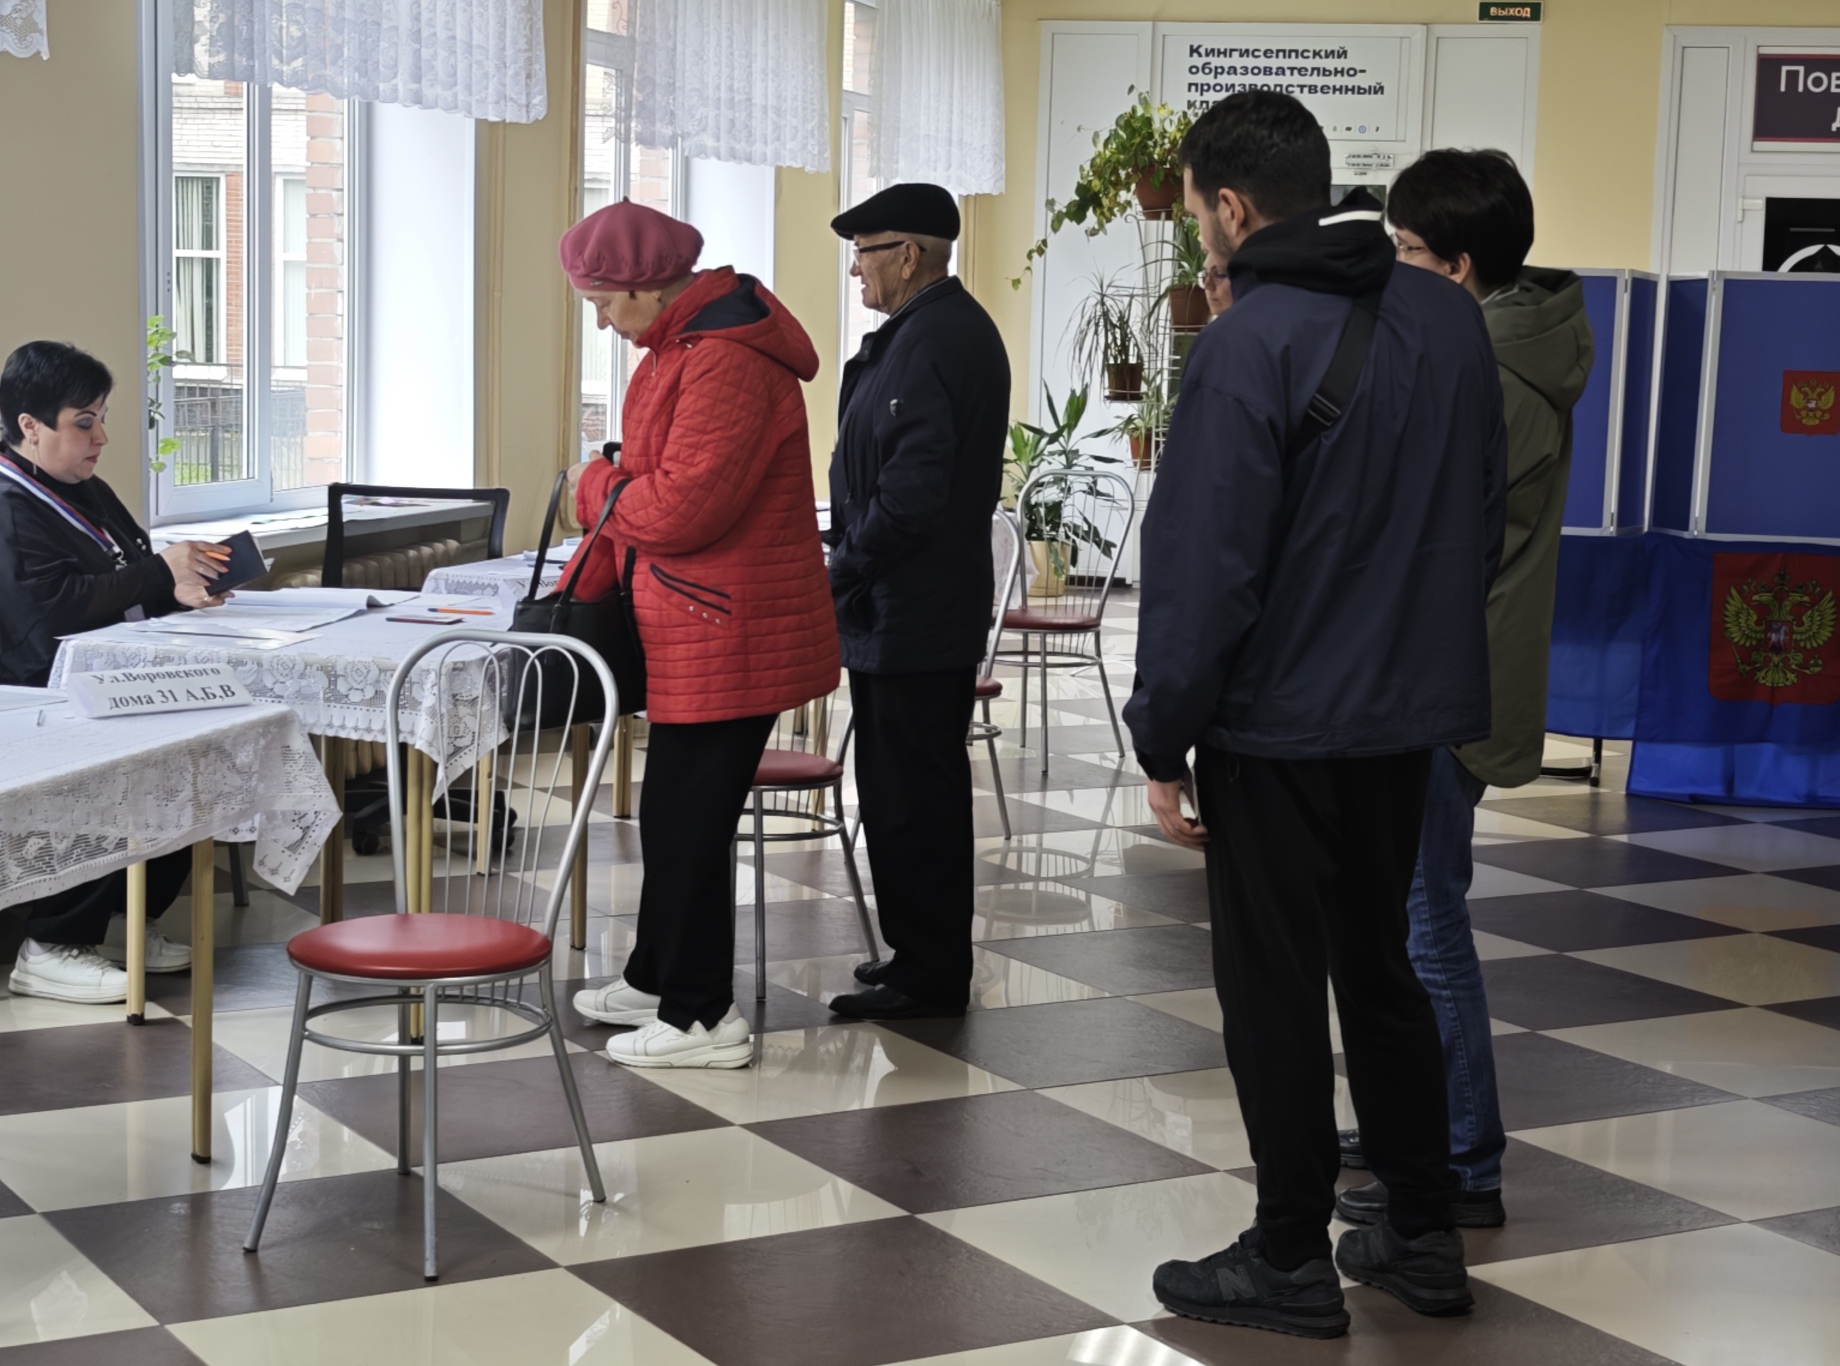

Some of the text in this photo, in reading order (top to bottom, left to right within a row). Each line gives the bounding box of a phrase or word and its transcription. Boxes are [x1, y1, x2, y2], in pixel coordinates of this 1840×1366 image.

[1490, 6, 1531, 18] ВЫХОД
[1189, 44, 1348, 60] Кингисеппский
[1188, 62, 1367, 79] образовательно-
[108, 684, 236, 710] дома 31 А,Б,В
